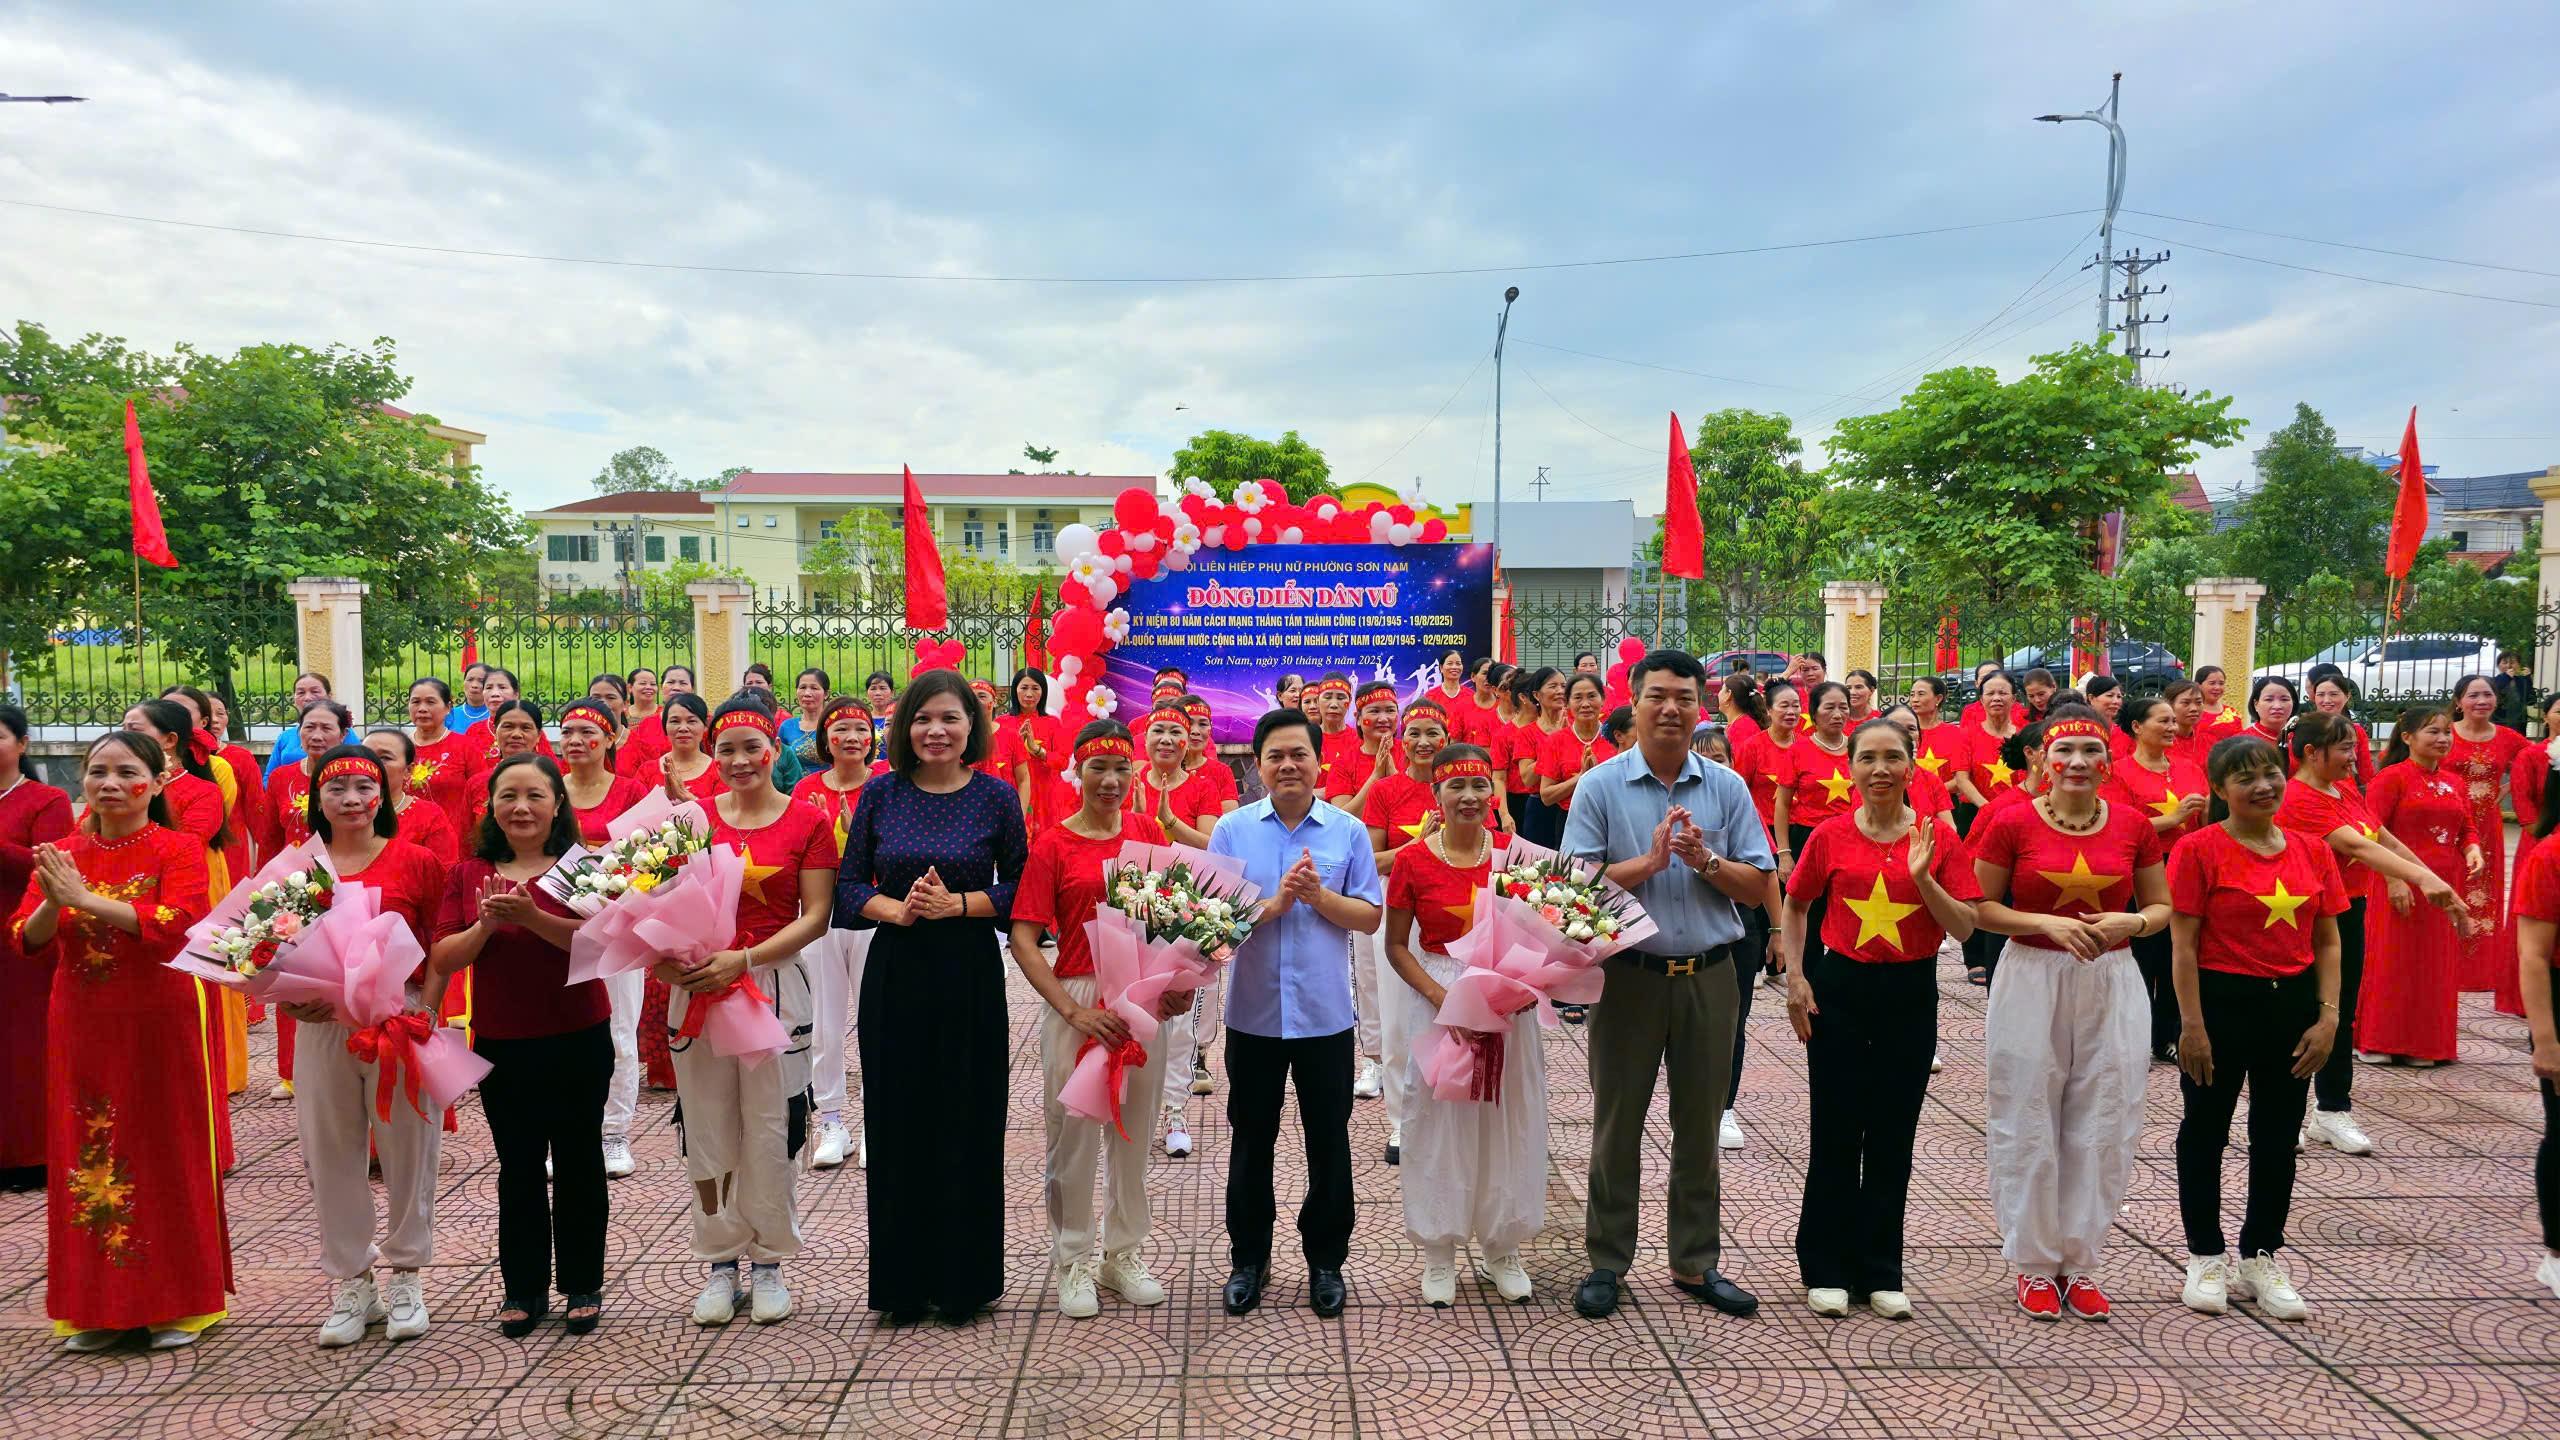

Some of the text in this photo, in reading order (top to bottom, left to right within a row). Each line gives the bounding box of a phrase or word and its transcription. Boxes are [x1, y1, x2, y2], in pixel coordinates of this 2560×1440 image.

[1185, 560, 1409, 574] ỘI LIÊN HIỆP PHỤ NỮ PHƯỜNG SƠN NAM
[1187, 578, 1399, 608] ĐỒNG DIỄN DÂN VŨ
[1132, 612, 1144, 627] KỶ
[1146, 613, 1168, 629] NIỆM
[1169, 615, 1180, 627] 80
[1182, 613, 1202, 627] NĂM
[1204, 613, 1226, 627] CÁCH
[1228, 615, 1253, 629] MẠNG
[1255, 613, 1282, 627] THÁNG
[1284, 613, 1302, 627] TÁM
[1304, 613, 1331, 627] THÀNH
[1333, 613, 1356, 627] CÔNG
[1358, 615, 1402, 628] (19/8/1945
[1409, 615, 1453, 627] 19/8/2025)
[1132, 631, 1155, 647] QUỐC
[1156, 632, 1185, 646] KHÁNH
[1187, 632, 1210, 646] NƯỚC
[1212, 632, 1235, 648] CỘNG
[1237, 632, 1254, 646] HÒA
[1256, 632, 1267, 646] XÃ
[1269, 632, 1283, 648] HỘI
[1285, 631, 1302, 646] CHỦ
[1304, 632, 1329, 646] NGHĨA
[1331, 632, 1349, 648] VIỆT
[1351, 634, 1370, 646] NAM
[1372, 634, 1416, 647] (02/9/1945
[1423, 634, 1467, 646] 02/9/2025)
[1204, 655, 1382, 668] Sơn Nam, ngày 30 tháng 8 năm 2025
[355, 761, 379, 777] NAM
